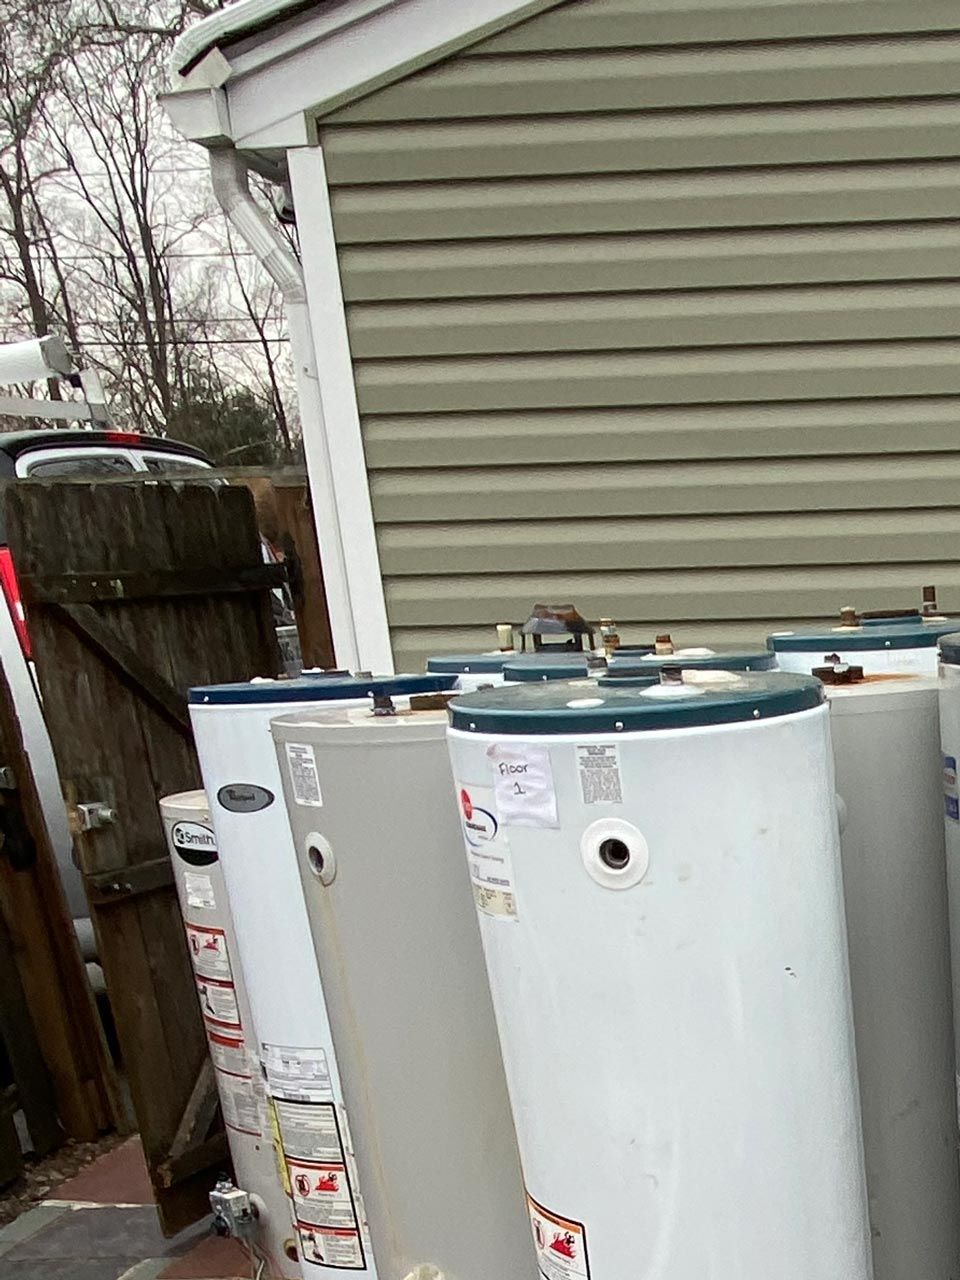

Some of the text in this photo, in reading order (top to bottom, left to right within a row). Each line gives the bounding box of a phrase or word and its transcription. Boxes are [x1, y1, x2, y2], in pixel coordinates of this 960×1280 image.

[498, 762, 529, 776] Floor
[513, 782, 526, 795] 1
[185, 832, 215, 845] Smith
